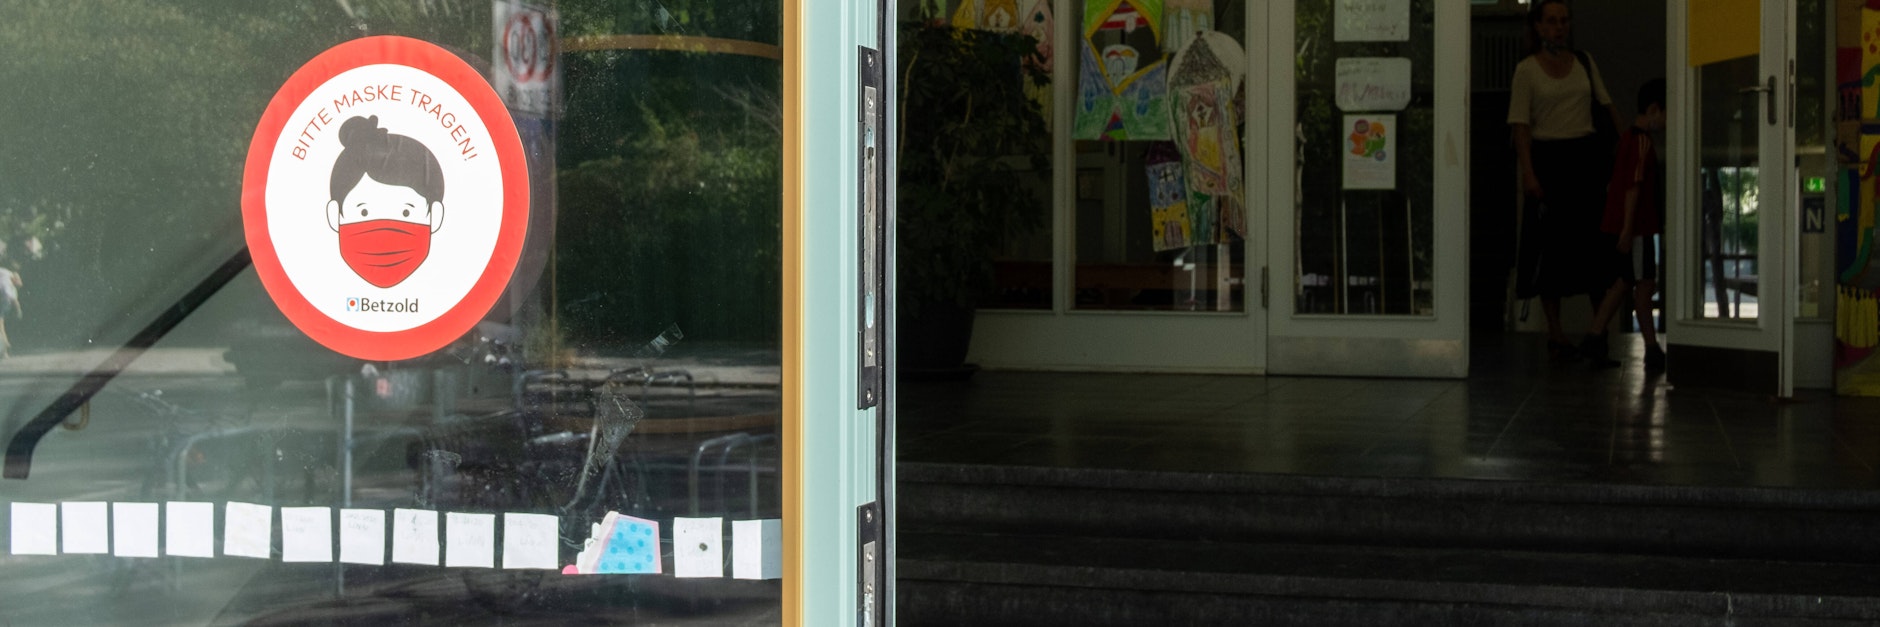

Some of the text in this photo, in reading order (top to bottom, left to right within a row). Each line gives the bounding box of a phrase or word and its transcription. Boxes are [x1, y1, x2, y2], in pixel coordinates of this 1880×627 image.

[292, 108, 333, 161] BITTE
[333, 84, 403, 113] MASKE
[410, 88, 478, 162] TRAGEN!
[361, 297, 419, 313] Betzold
